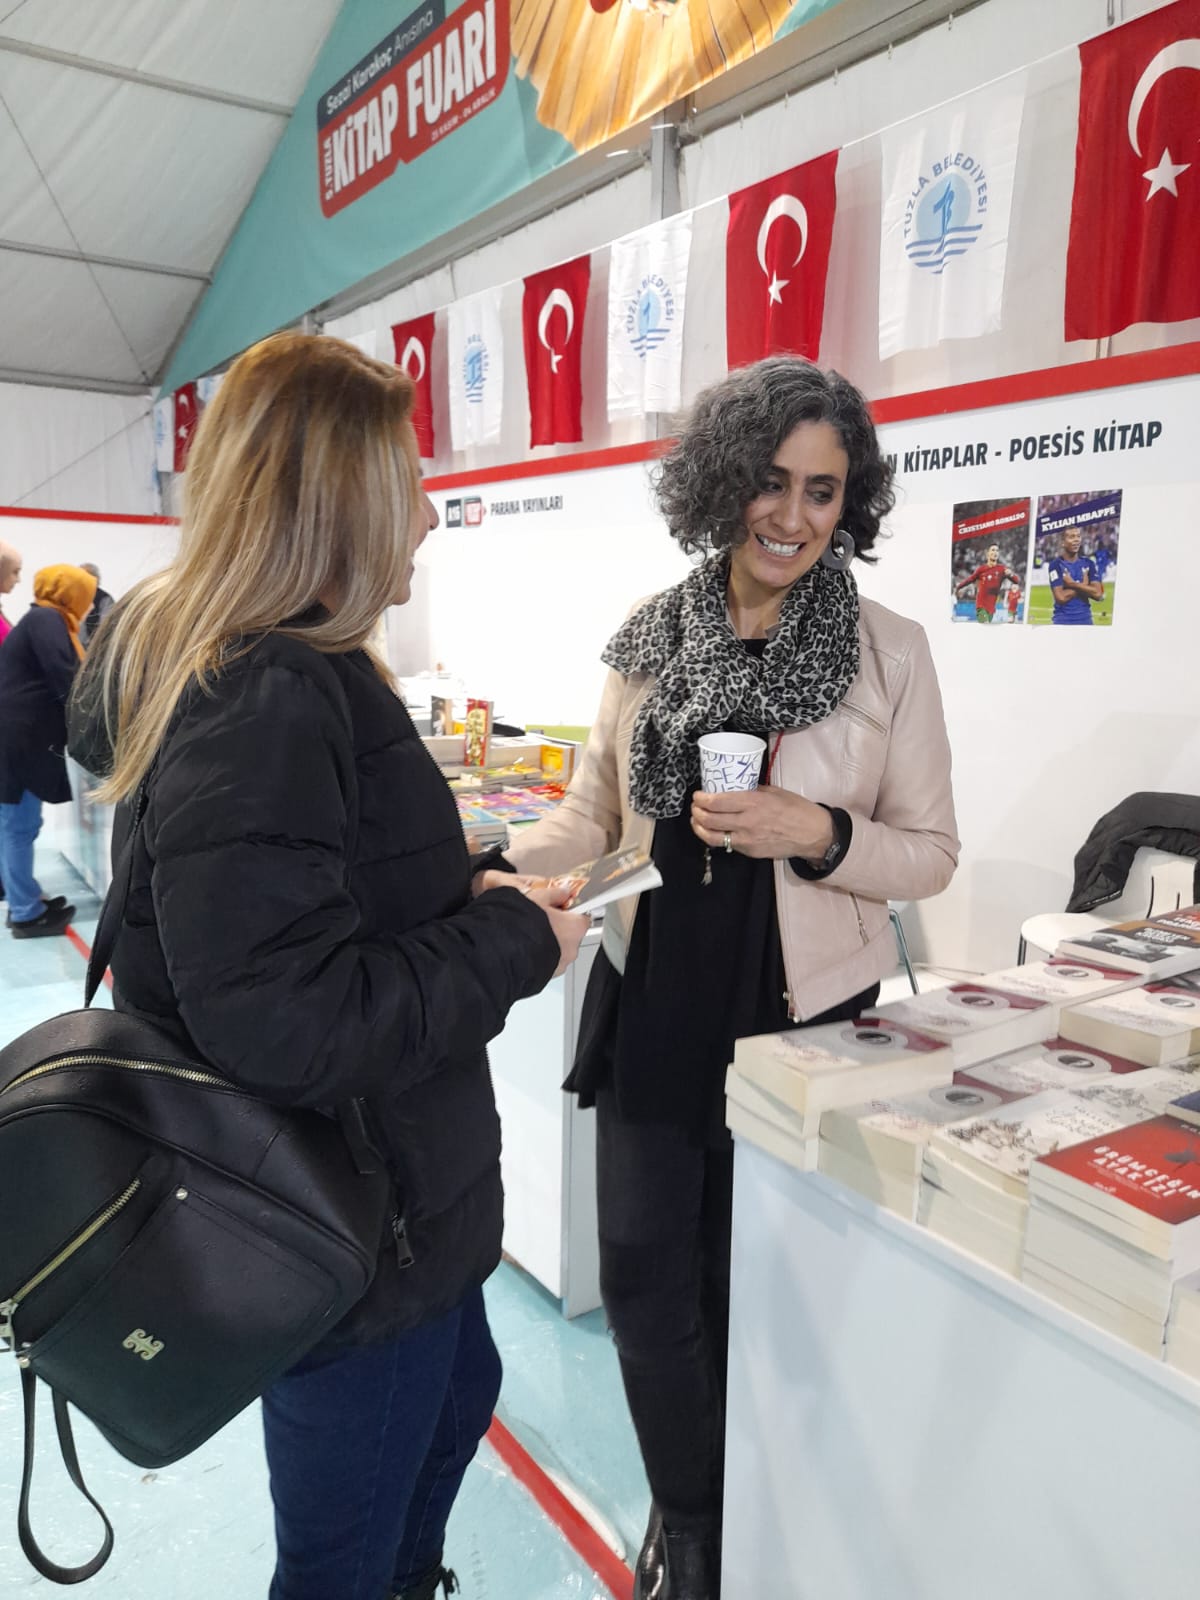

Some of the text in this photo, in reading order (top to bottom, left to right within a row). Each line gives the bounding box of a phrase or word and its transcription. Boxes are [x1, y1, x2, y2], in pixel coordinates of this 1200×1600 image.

[326, 9, 433, 115] Sezai Karakoç Anısına
[332, 0, 496, 193] KİTAP FUARI
[904, 175, 930, 239] TUZLA
[642, 274, 674, 321] BLEDİYESİ
[904, 442, 988, 473] KİTAPLAR
[1009, 425, 1085, 462] POESİS
[1092, 419, 1162, 453] KİTAP
[490, 500, 520, 516] PARANA
[522, 495, 563, 513] YAYINLARI
[958, 511, 1026, 534] CRISTIANO RONALDO
[1042, 515, 1076, 532] KYLIAN
[1093, 1157, 1143, 1181] AYAK
